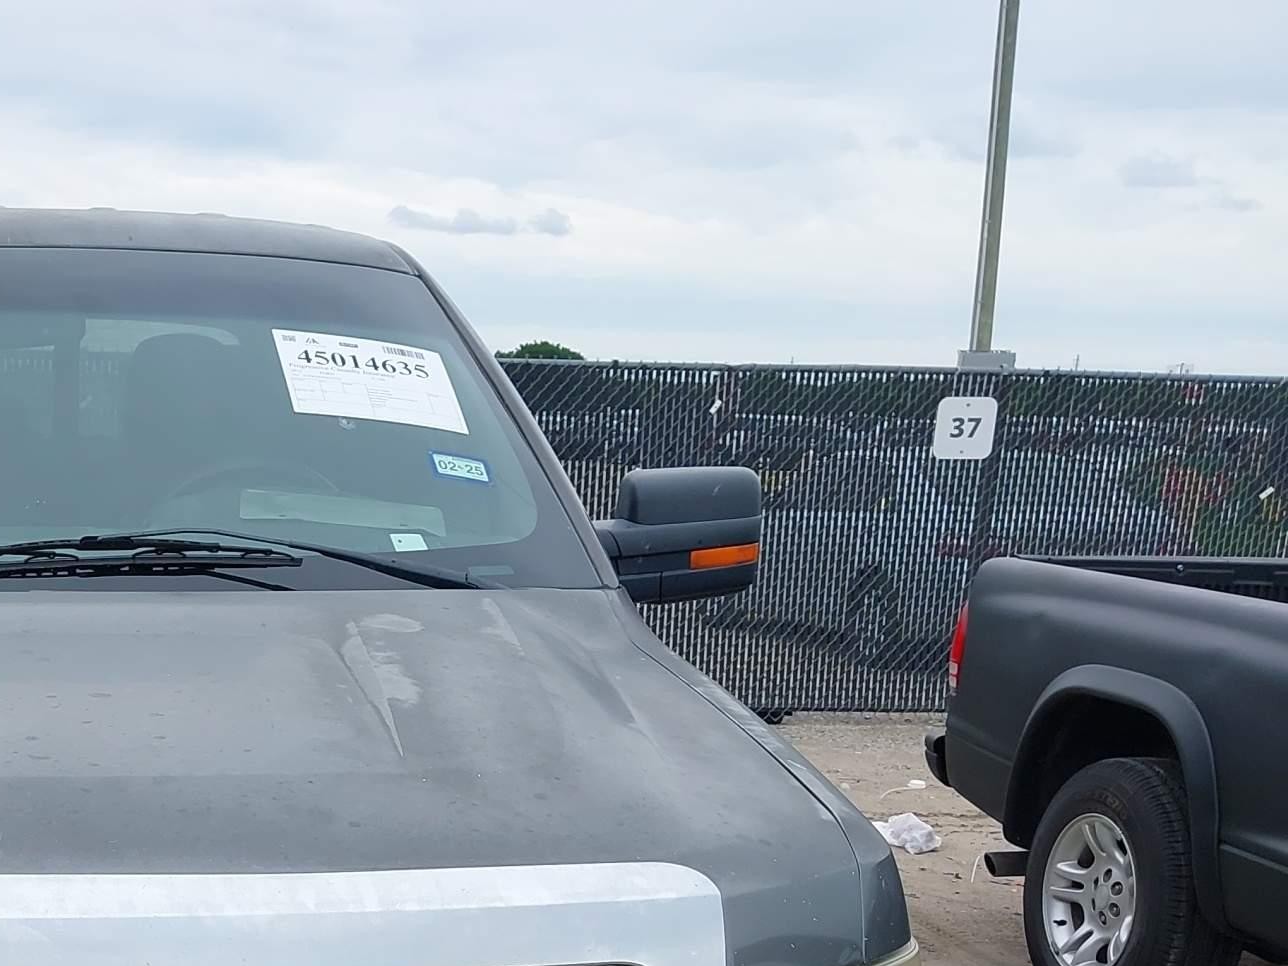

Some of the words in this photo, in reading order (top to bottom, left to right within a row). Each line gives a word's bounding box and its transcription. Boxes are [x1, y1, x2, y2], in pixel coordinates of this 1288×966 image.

[297, 350, 429, 379] 45014635
[949, 417, 982, 438] 37
[438, 460, 484, 476] 02-25
